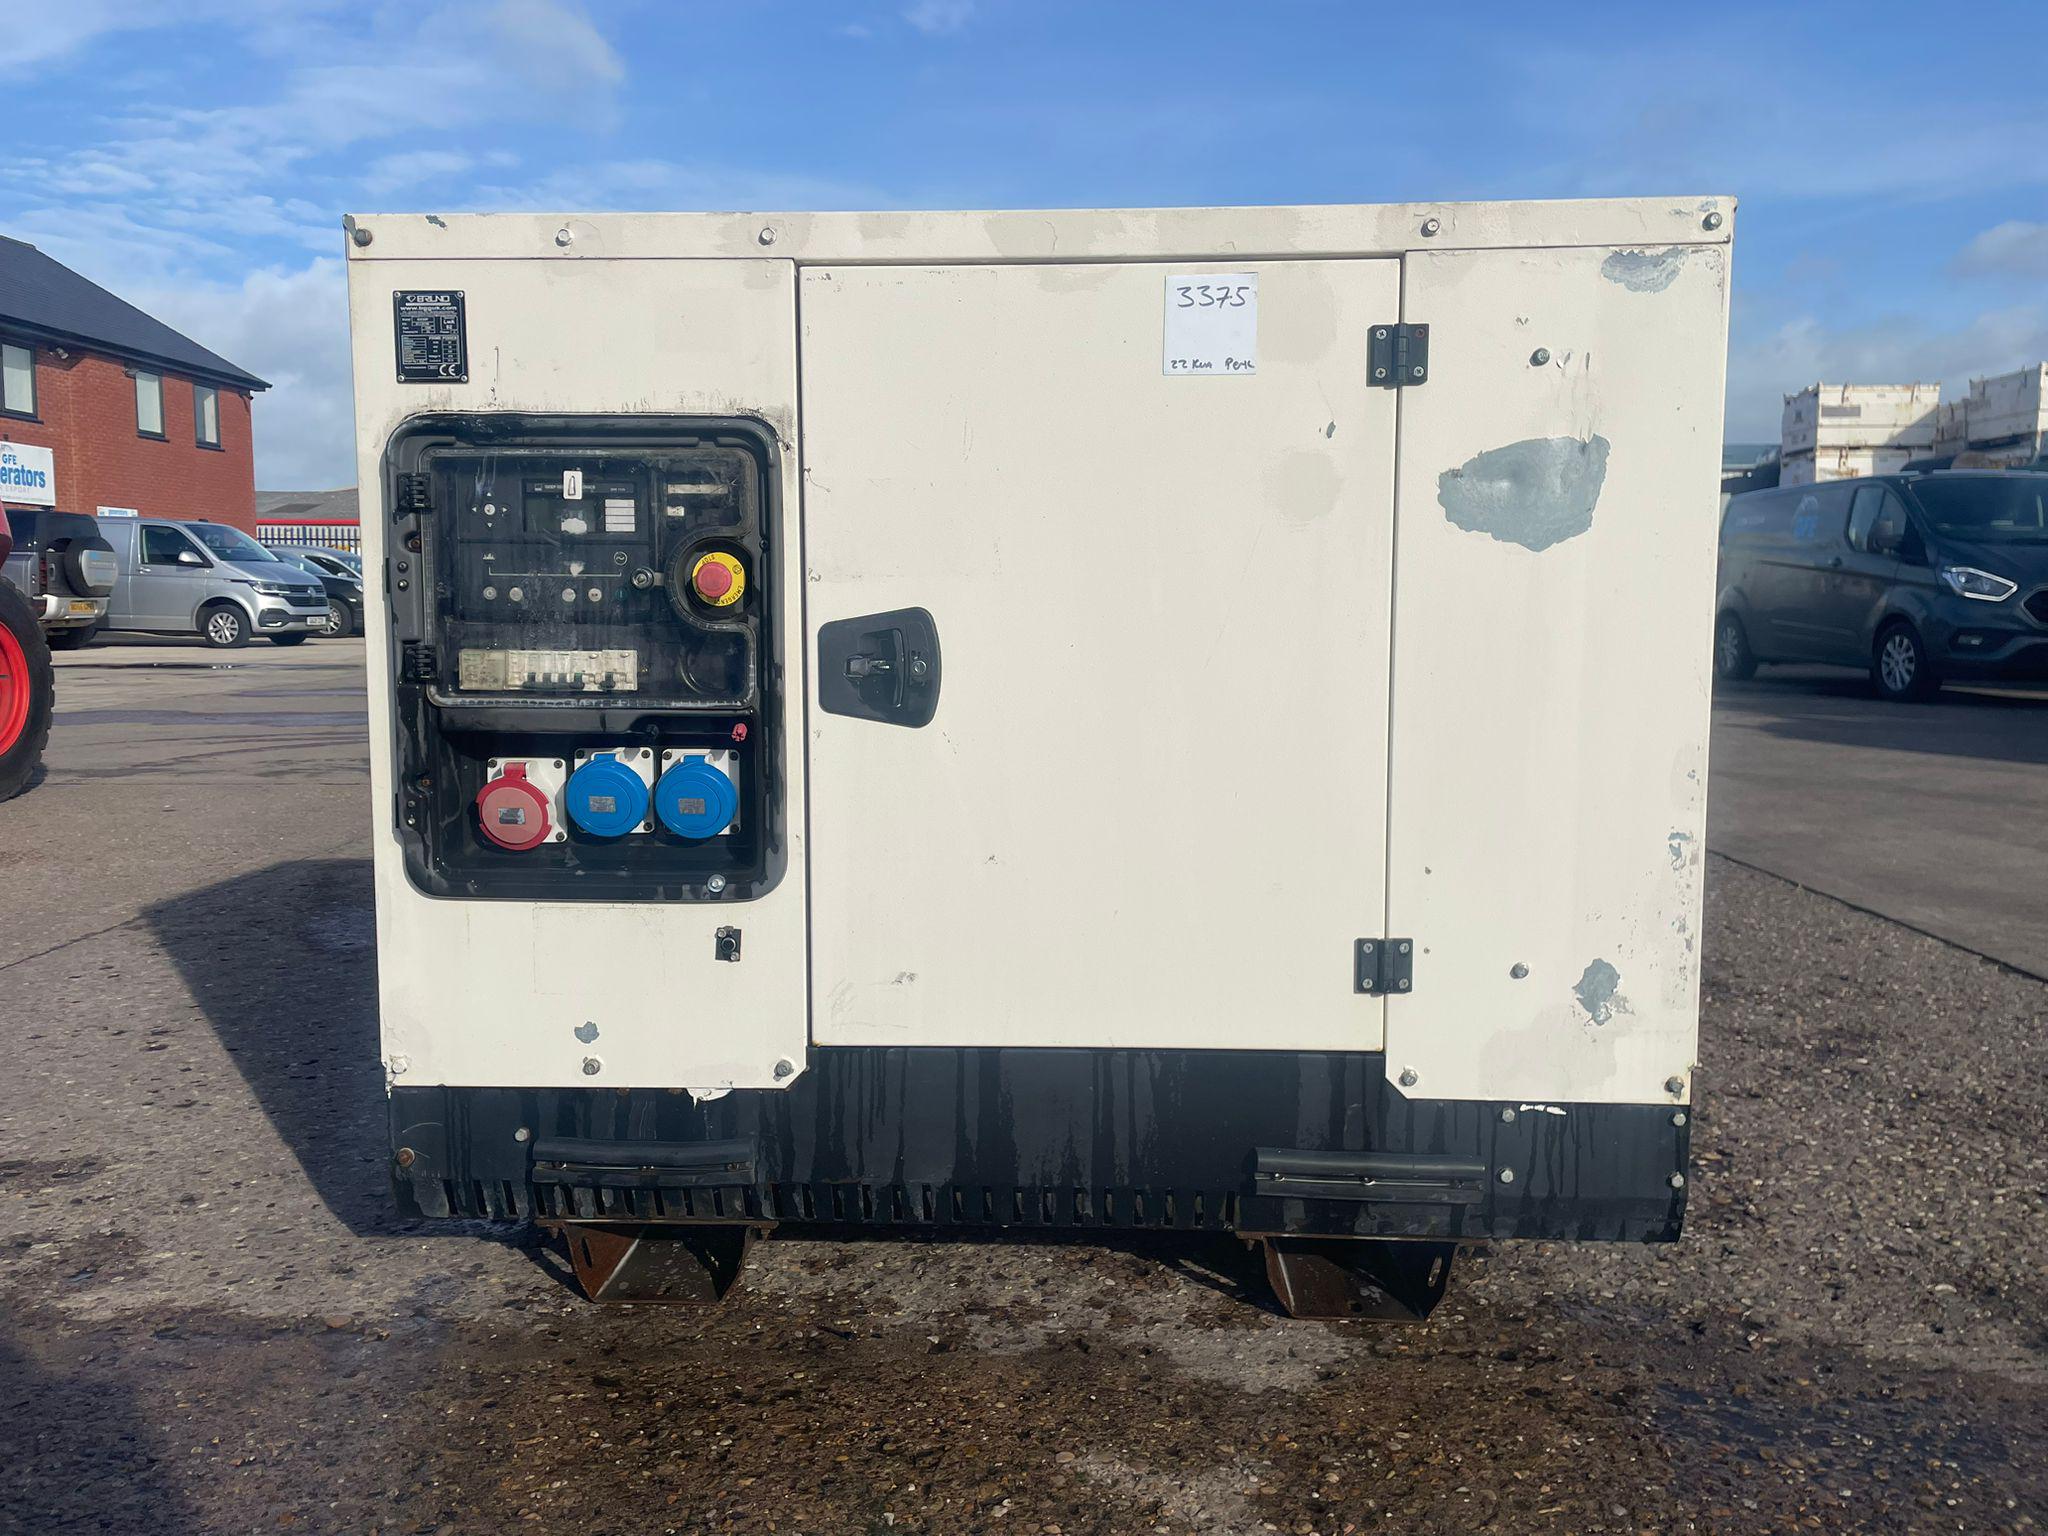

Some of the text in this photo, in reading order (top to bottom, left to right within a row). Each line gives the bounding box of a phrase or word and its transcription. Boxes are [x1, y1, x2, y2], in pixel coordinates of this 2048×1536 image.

[416, 295, 450, 303] BRUNO
[1176, 285, 1250, 309] 3375
[439, 364, 456, 376] CE
[1170, 359, 1188, 370] 22
[2, 453, 17, 465] GFE
